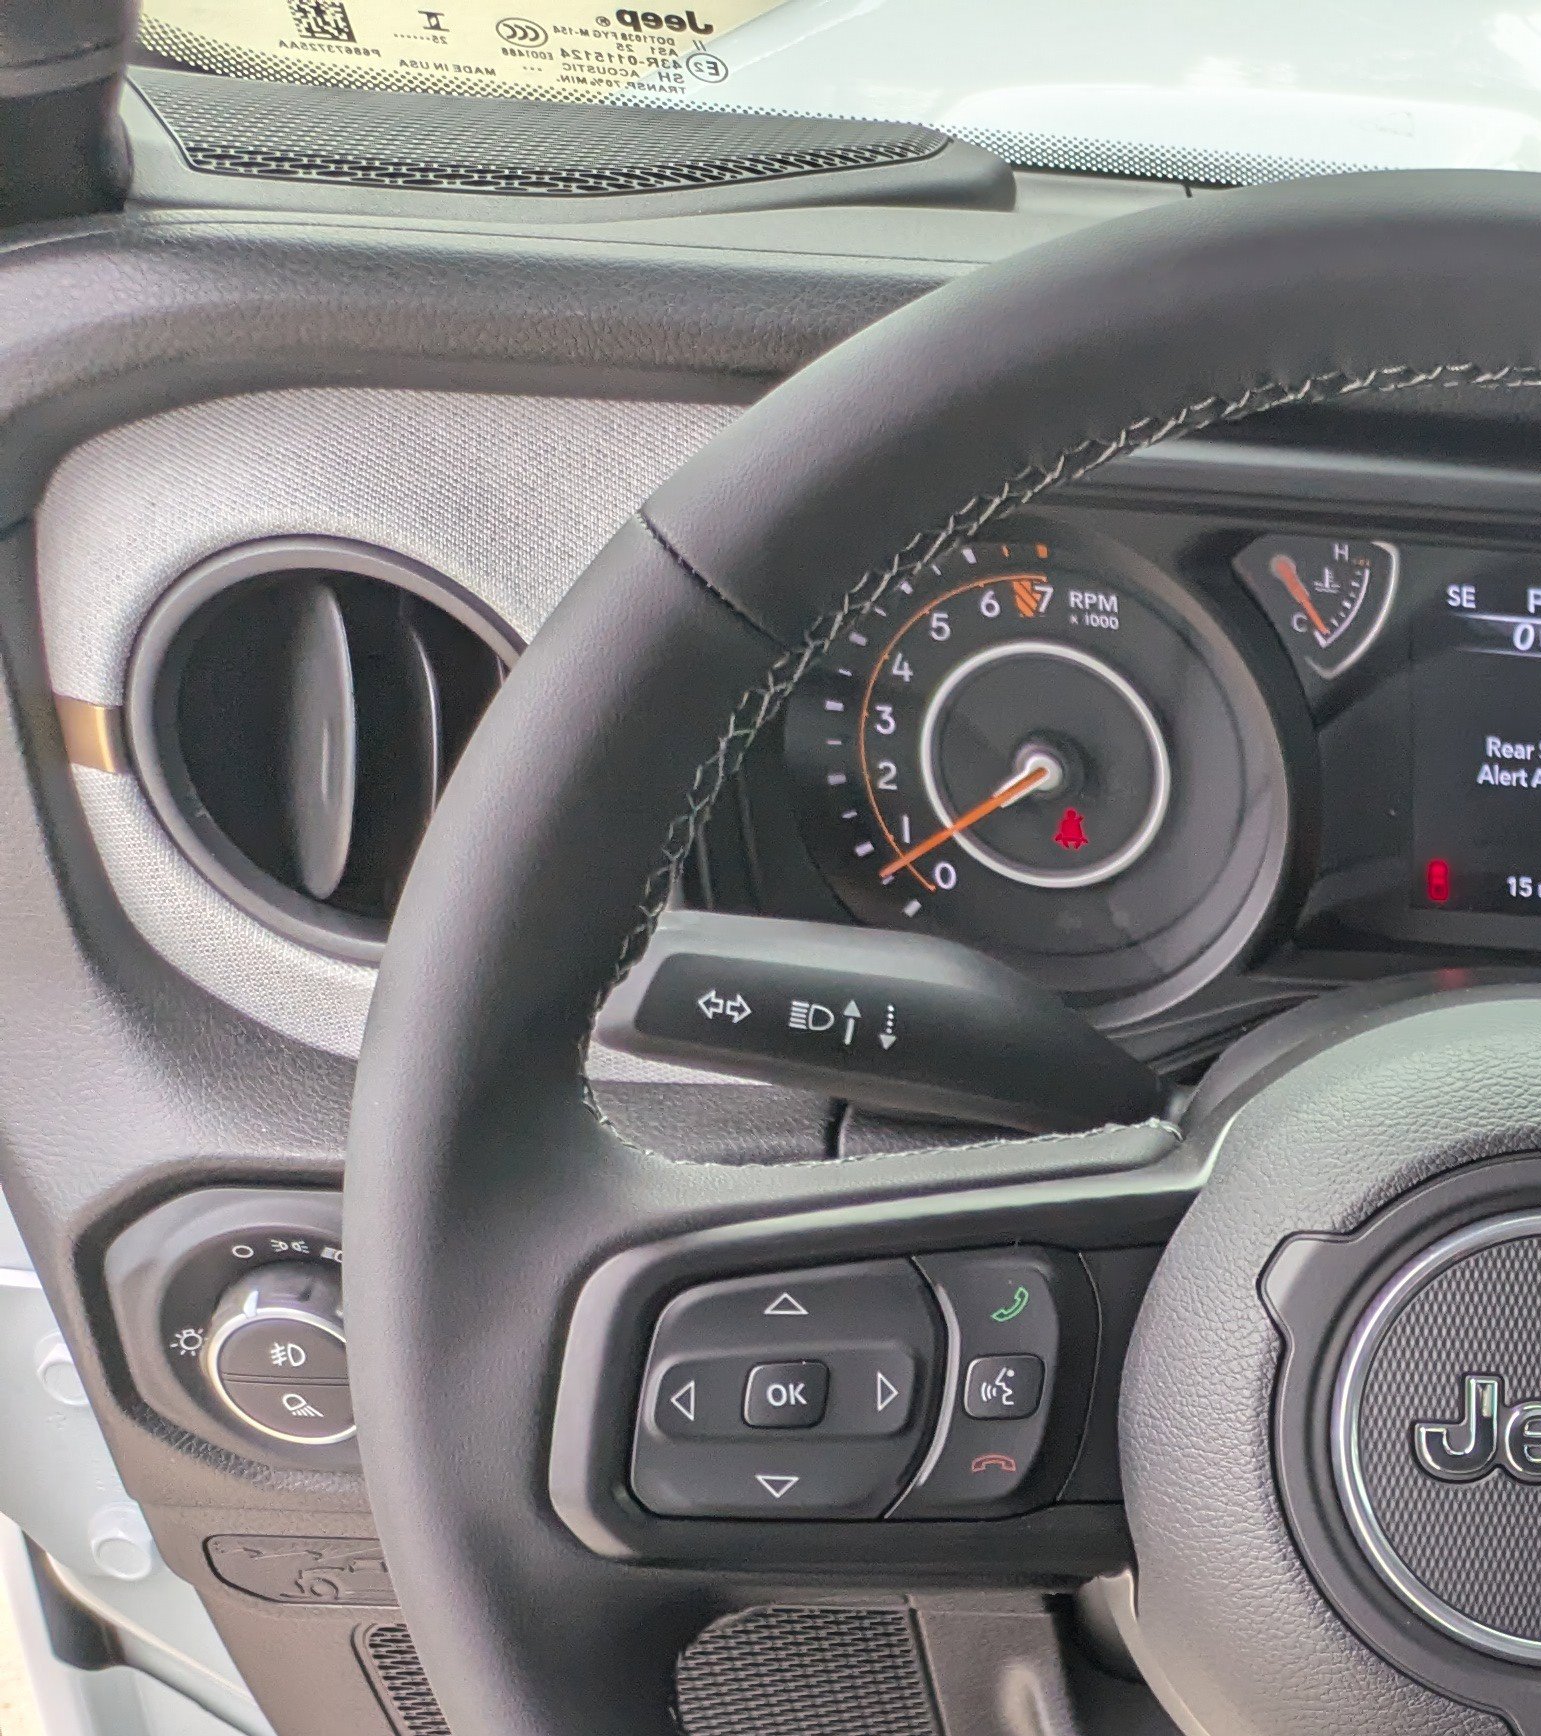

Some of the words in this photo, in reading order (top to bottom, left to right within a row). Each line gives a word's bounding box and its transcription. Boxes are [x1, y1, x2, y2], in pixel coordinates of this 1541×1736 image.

[981, 591, 1000, 616] 6
[1034, 585, 1054, 613] 7
[1069, 591, 1119, 614] RPM
[1447, 585, 1475, 609] SE
[930, 613, 950, 641] 5
[1084, 613, 1119, 630] 1000
[1512, 624, 1534, 650] 0
[892, 654, 912, 681] 4
[876, 705, 895, 733] 3
[1486, 736, 1534, 761] Rear
[878, 762, 897, 790] 2
[1477, 765, 1527, 789] Alert
[934, 862, 955, 889] 0
[1507, 876, 1532, 897] 15
[766, 1383, 807, 1408] OK
